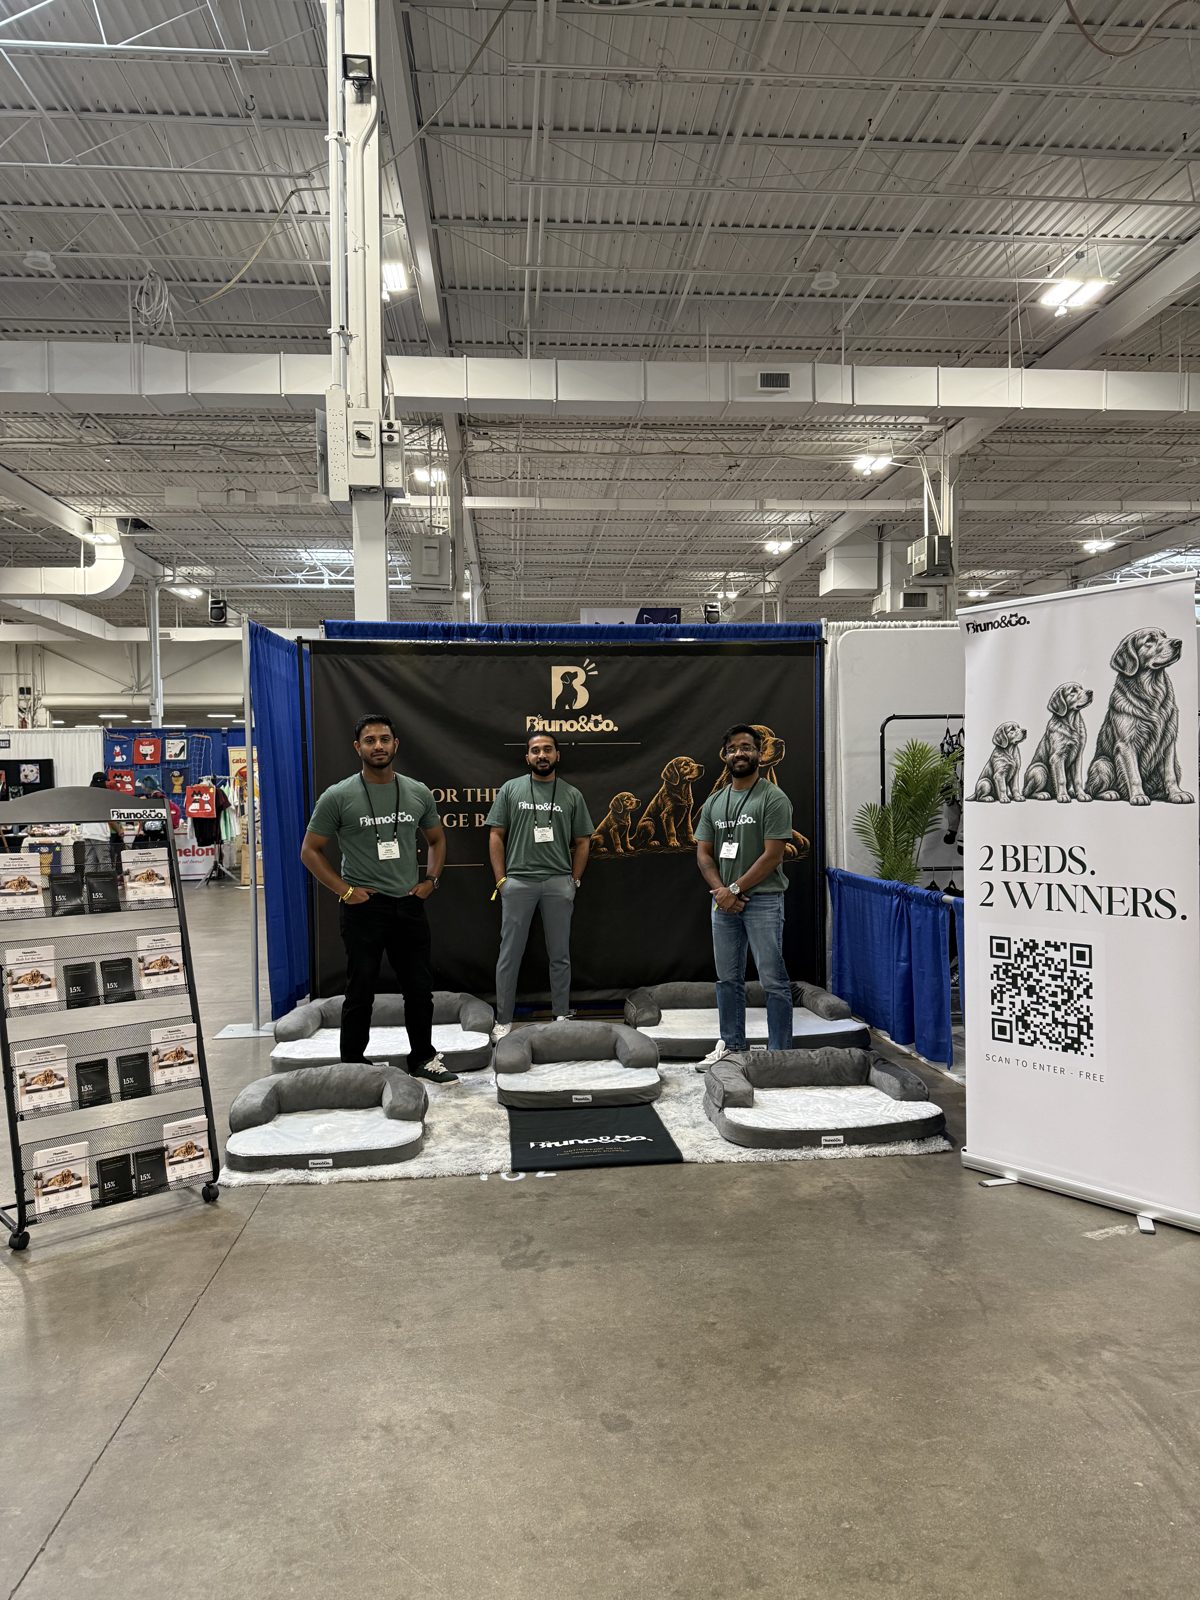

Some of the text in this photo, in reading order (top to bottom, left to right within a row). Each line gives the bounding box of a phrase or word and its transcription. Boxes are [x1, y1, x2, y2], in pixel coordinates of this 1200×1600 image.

[966, 613, 1030, 634] Bruno&Co.
[526, 714, 619, 732] Bruno&Co.
[431, 788, 460, 803] OR
[111, 809, 166, 819] Bruno&Co.
[438, 813, 470, 828] GE
[979, 844, 1096, 876] 2 BEDS.
[979, 881, 1188, 921] 2 WINNERS.
[985, 1053, 1011, 1065] SCAN
[1015, 1059, 1028, 1068] TO
[1032, 1062, 1066, 1075] ENTER
[1079, 1070, 1105, 1083] FREE
[530, 1135, 654, 1149] Bruno&Co.
